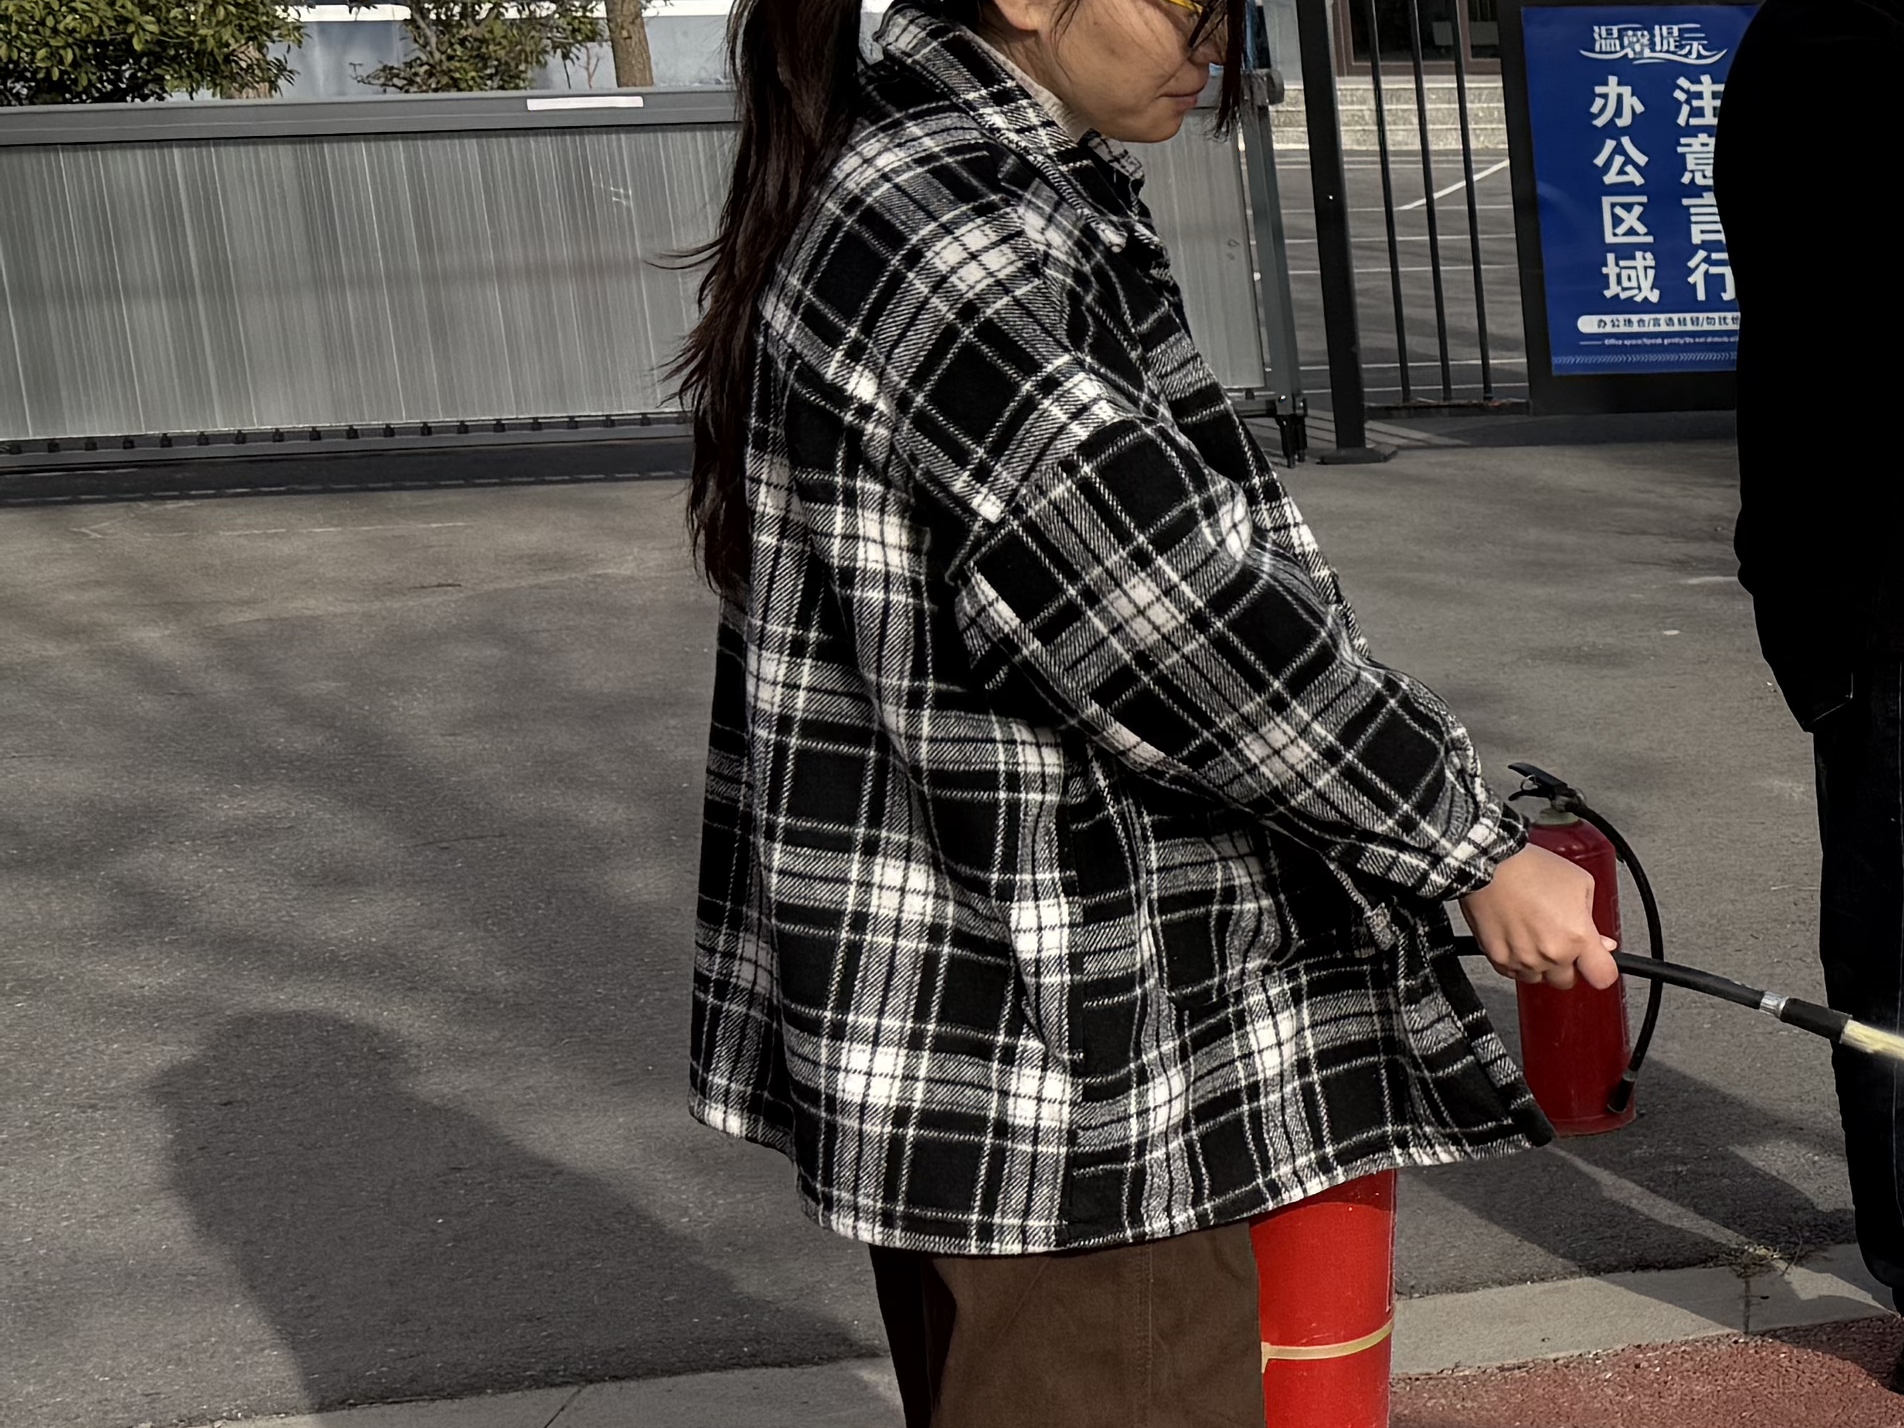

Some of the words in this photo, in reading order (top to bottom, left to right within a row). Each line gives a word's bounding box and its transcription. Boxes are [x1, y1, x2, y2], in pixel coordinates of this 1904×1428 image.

[1593, 24, 1718, 60] 温馨提示
[1589, 74, 1661, 304] 办公区域
[1673, 73, 1736, 302] 注意言行
